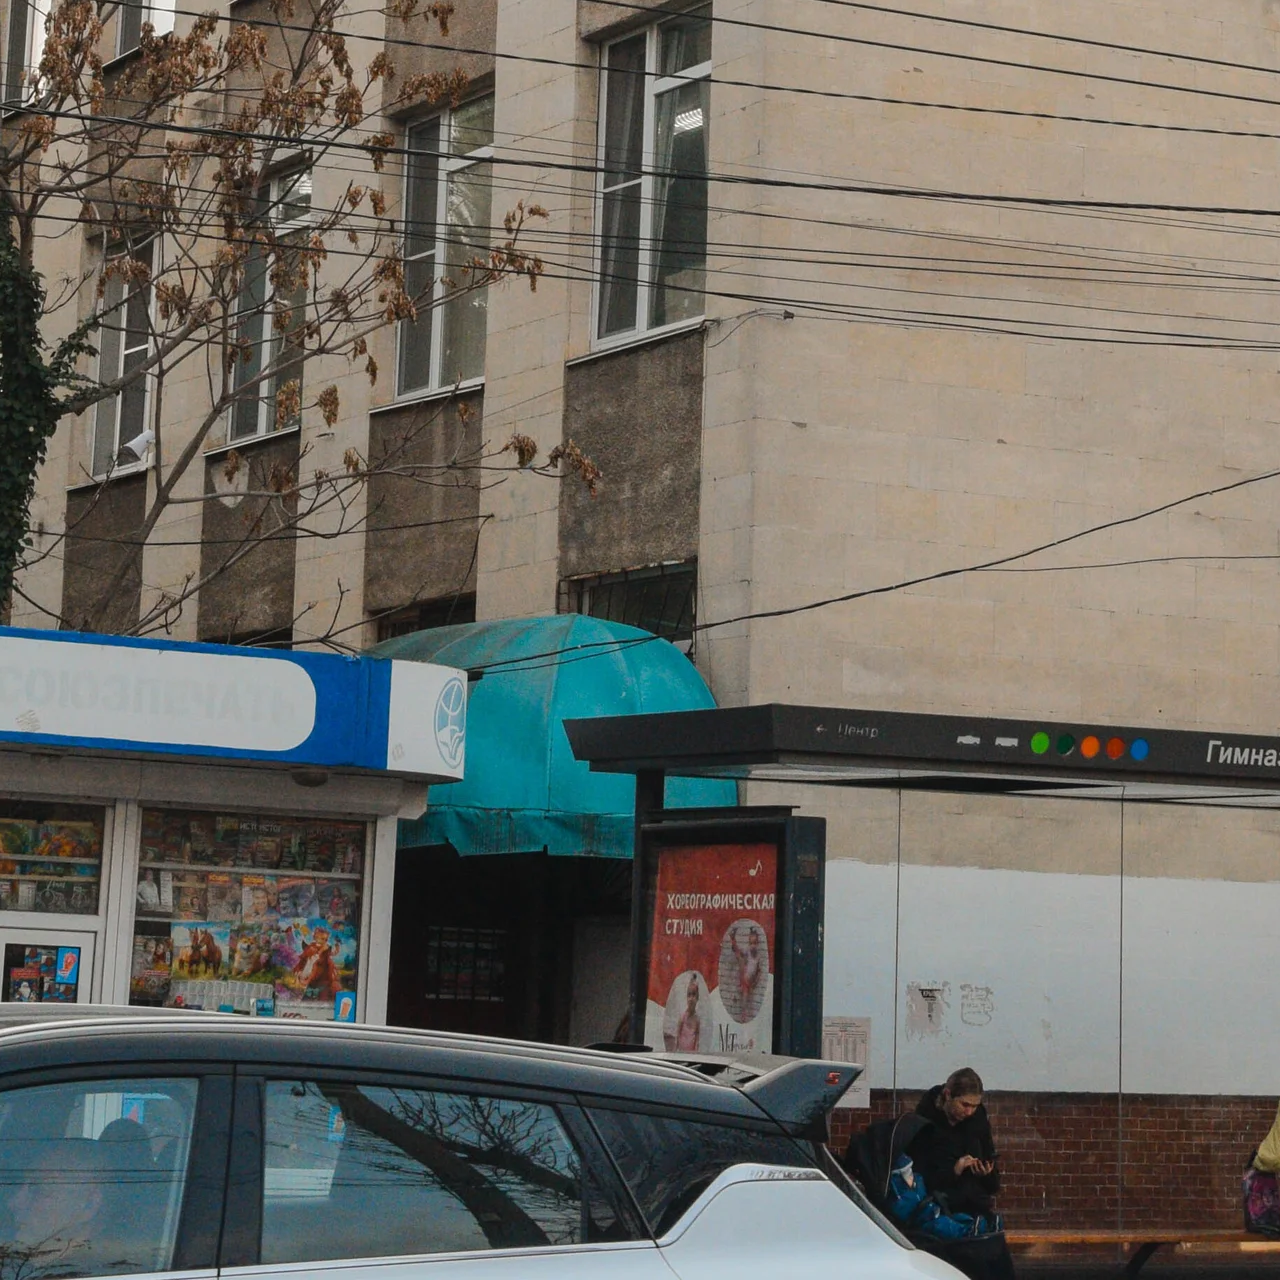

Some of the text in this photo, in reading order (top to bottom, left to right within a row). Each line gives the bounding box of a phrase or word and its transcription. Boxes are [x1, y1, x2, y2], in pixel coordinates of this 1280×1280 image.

[838, 723, 879, 740] Центр
[666, 893, 775, 910] ХОРЕОГРАФИЧЕСКАЯ
[665, 918, 703, 936] СТУДИЯ
